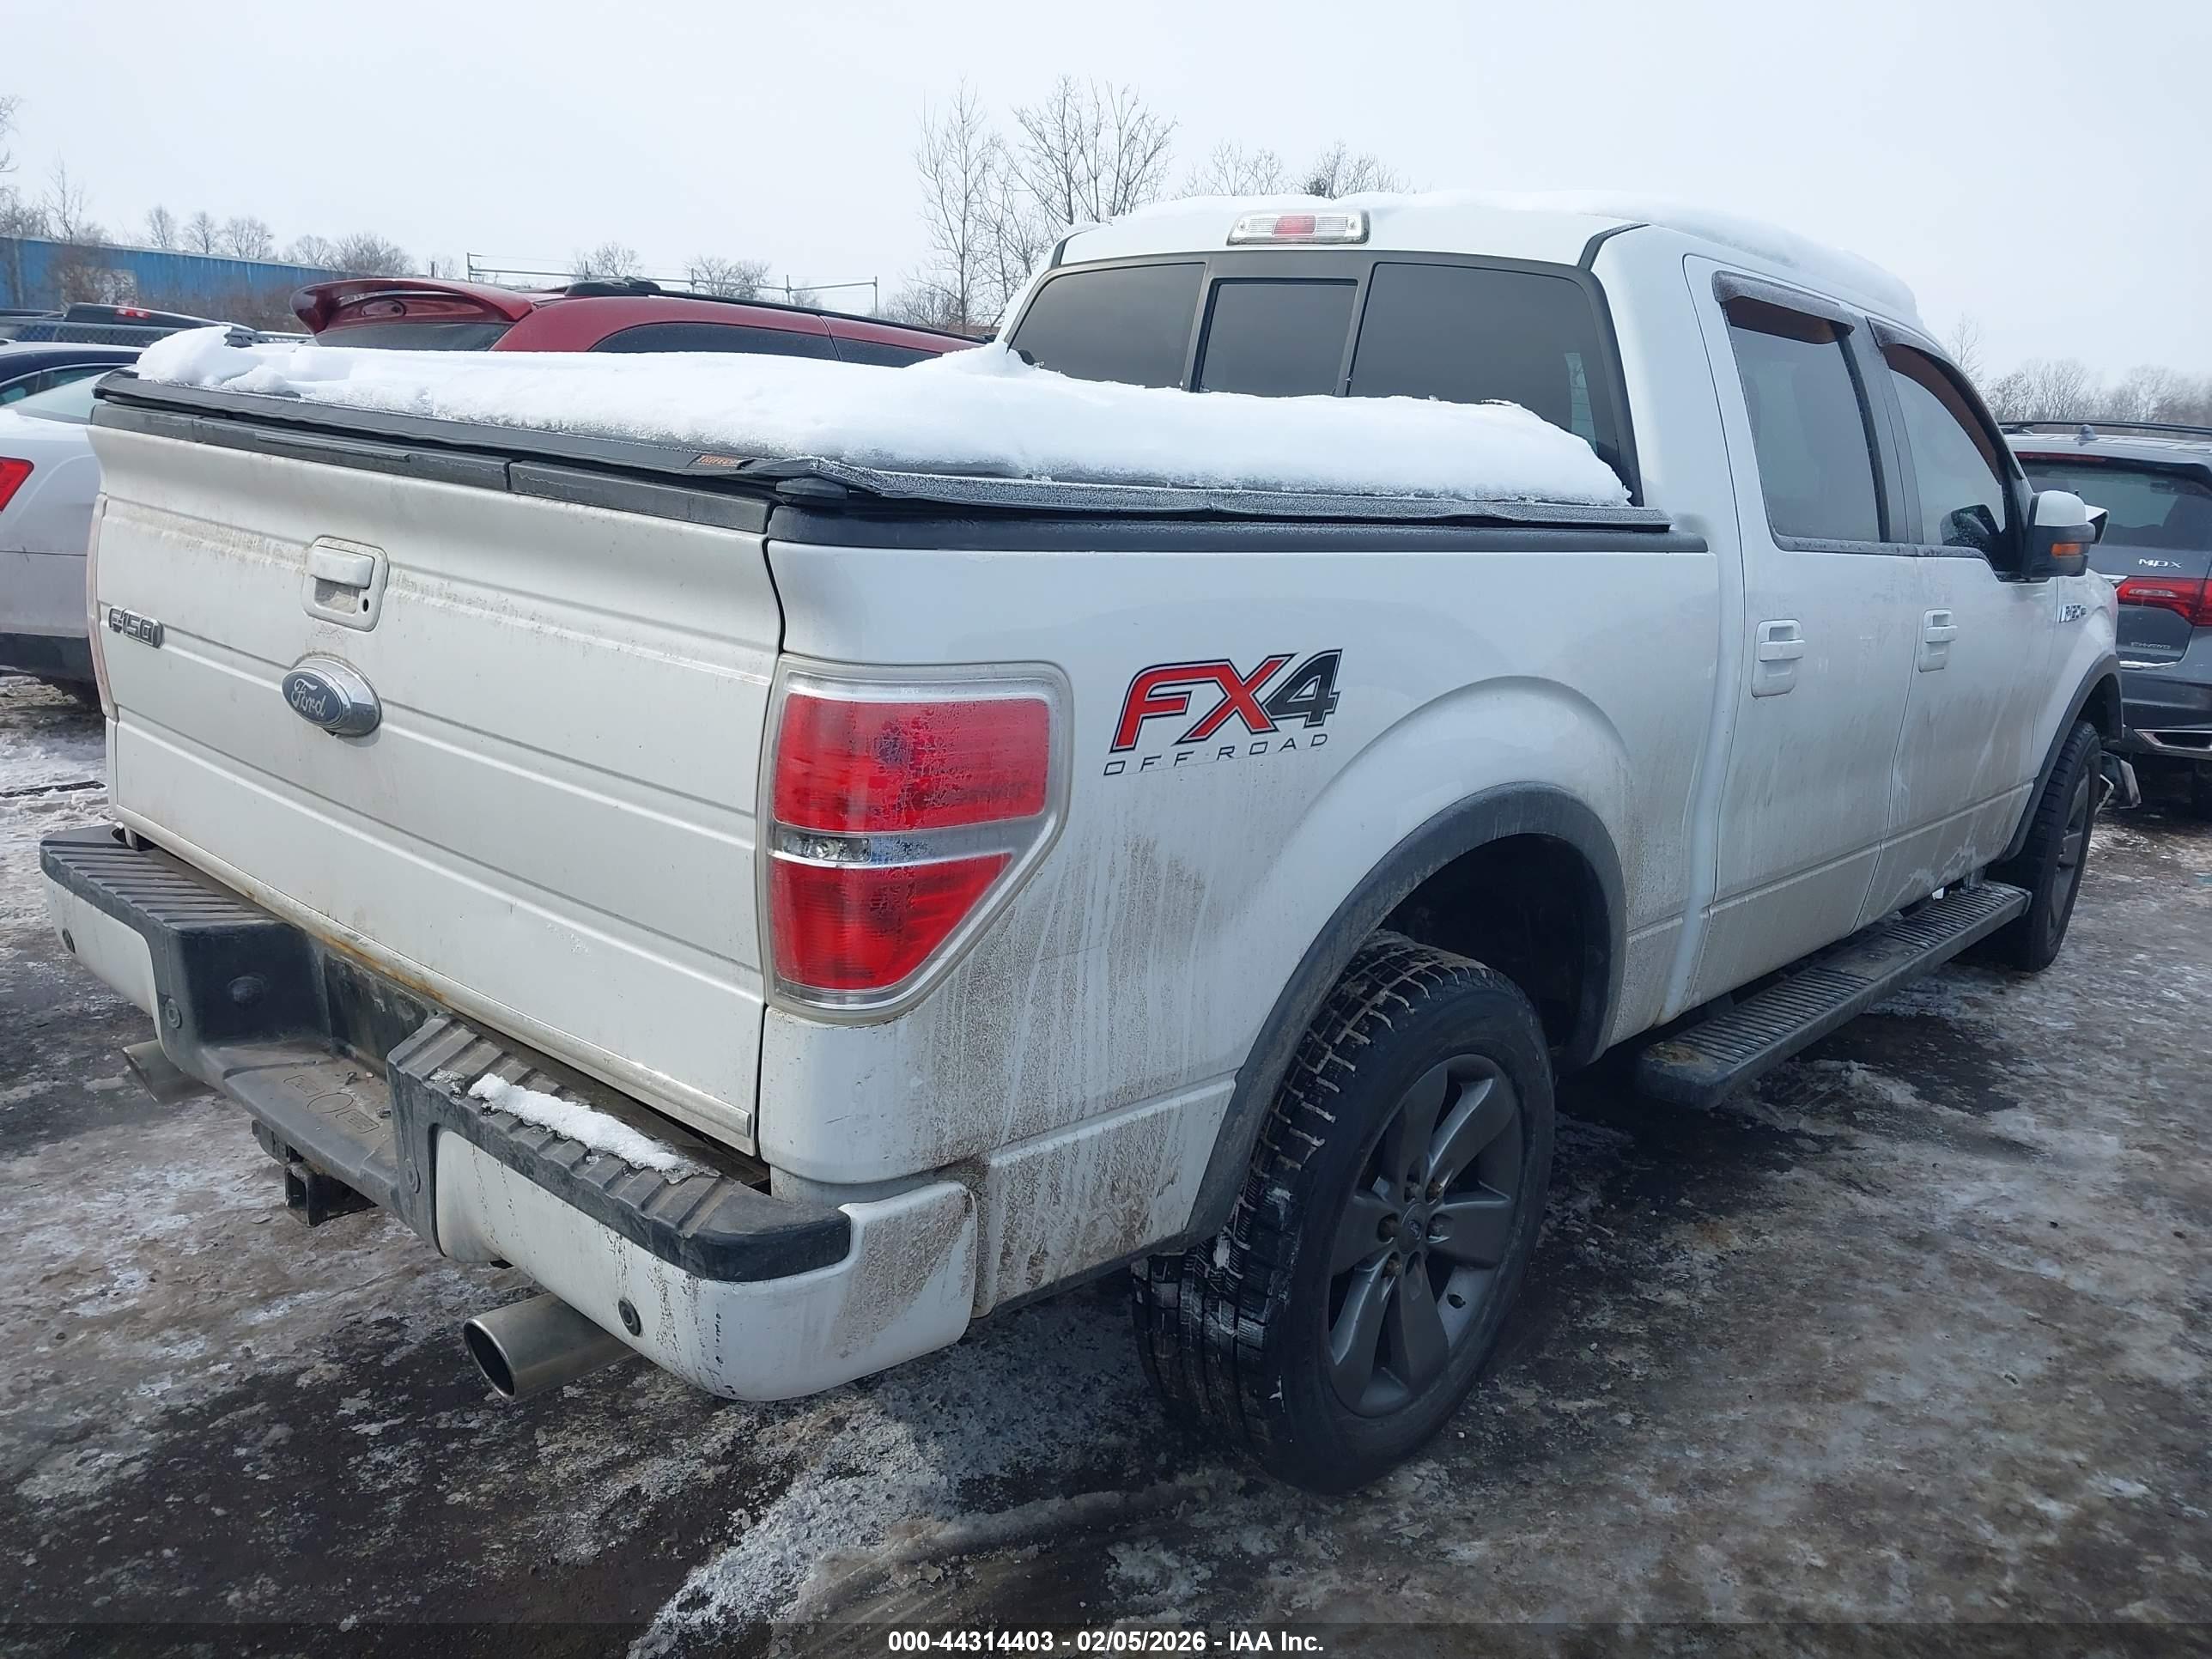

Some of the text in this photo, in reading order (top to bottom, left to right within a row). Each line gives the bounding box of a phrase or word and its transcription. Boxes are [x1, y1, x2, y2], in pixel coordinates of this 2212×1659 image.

[2138, 558, 2182, 568] MDX
[291, 678, 326, 717] Ford
[1109, 648, 1343, 753] FX4
[1103, 732, 1328, 776] OFF ROAD
